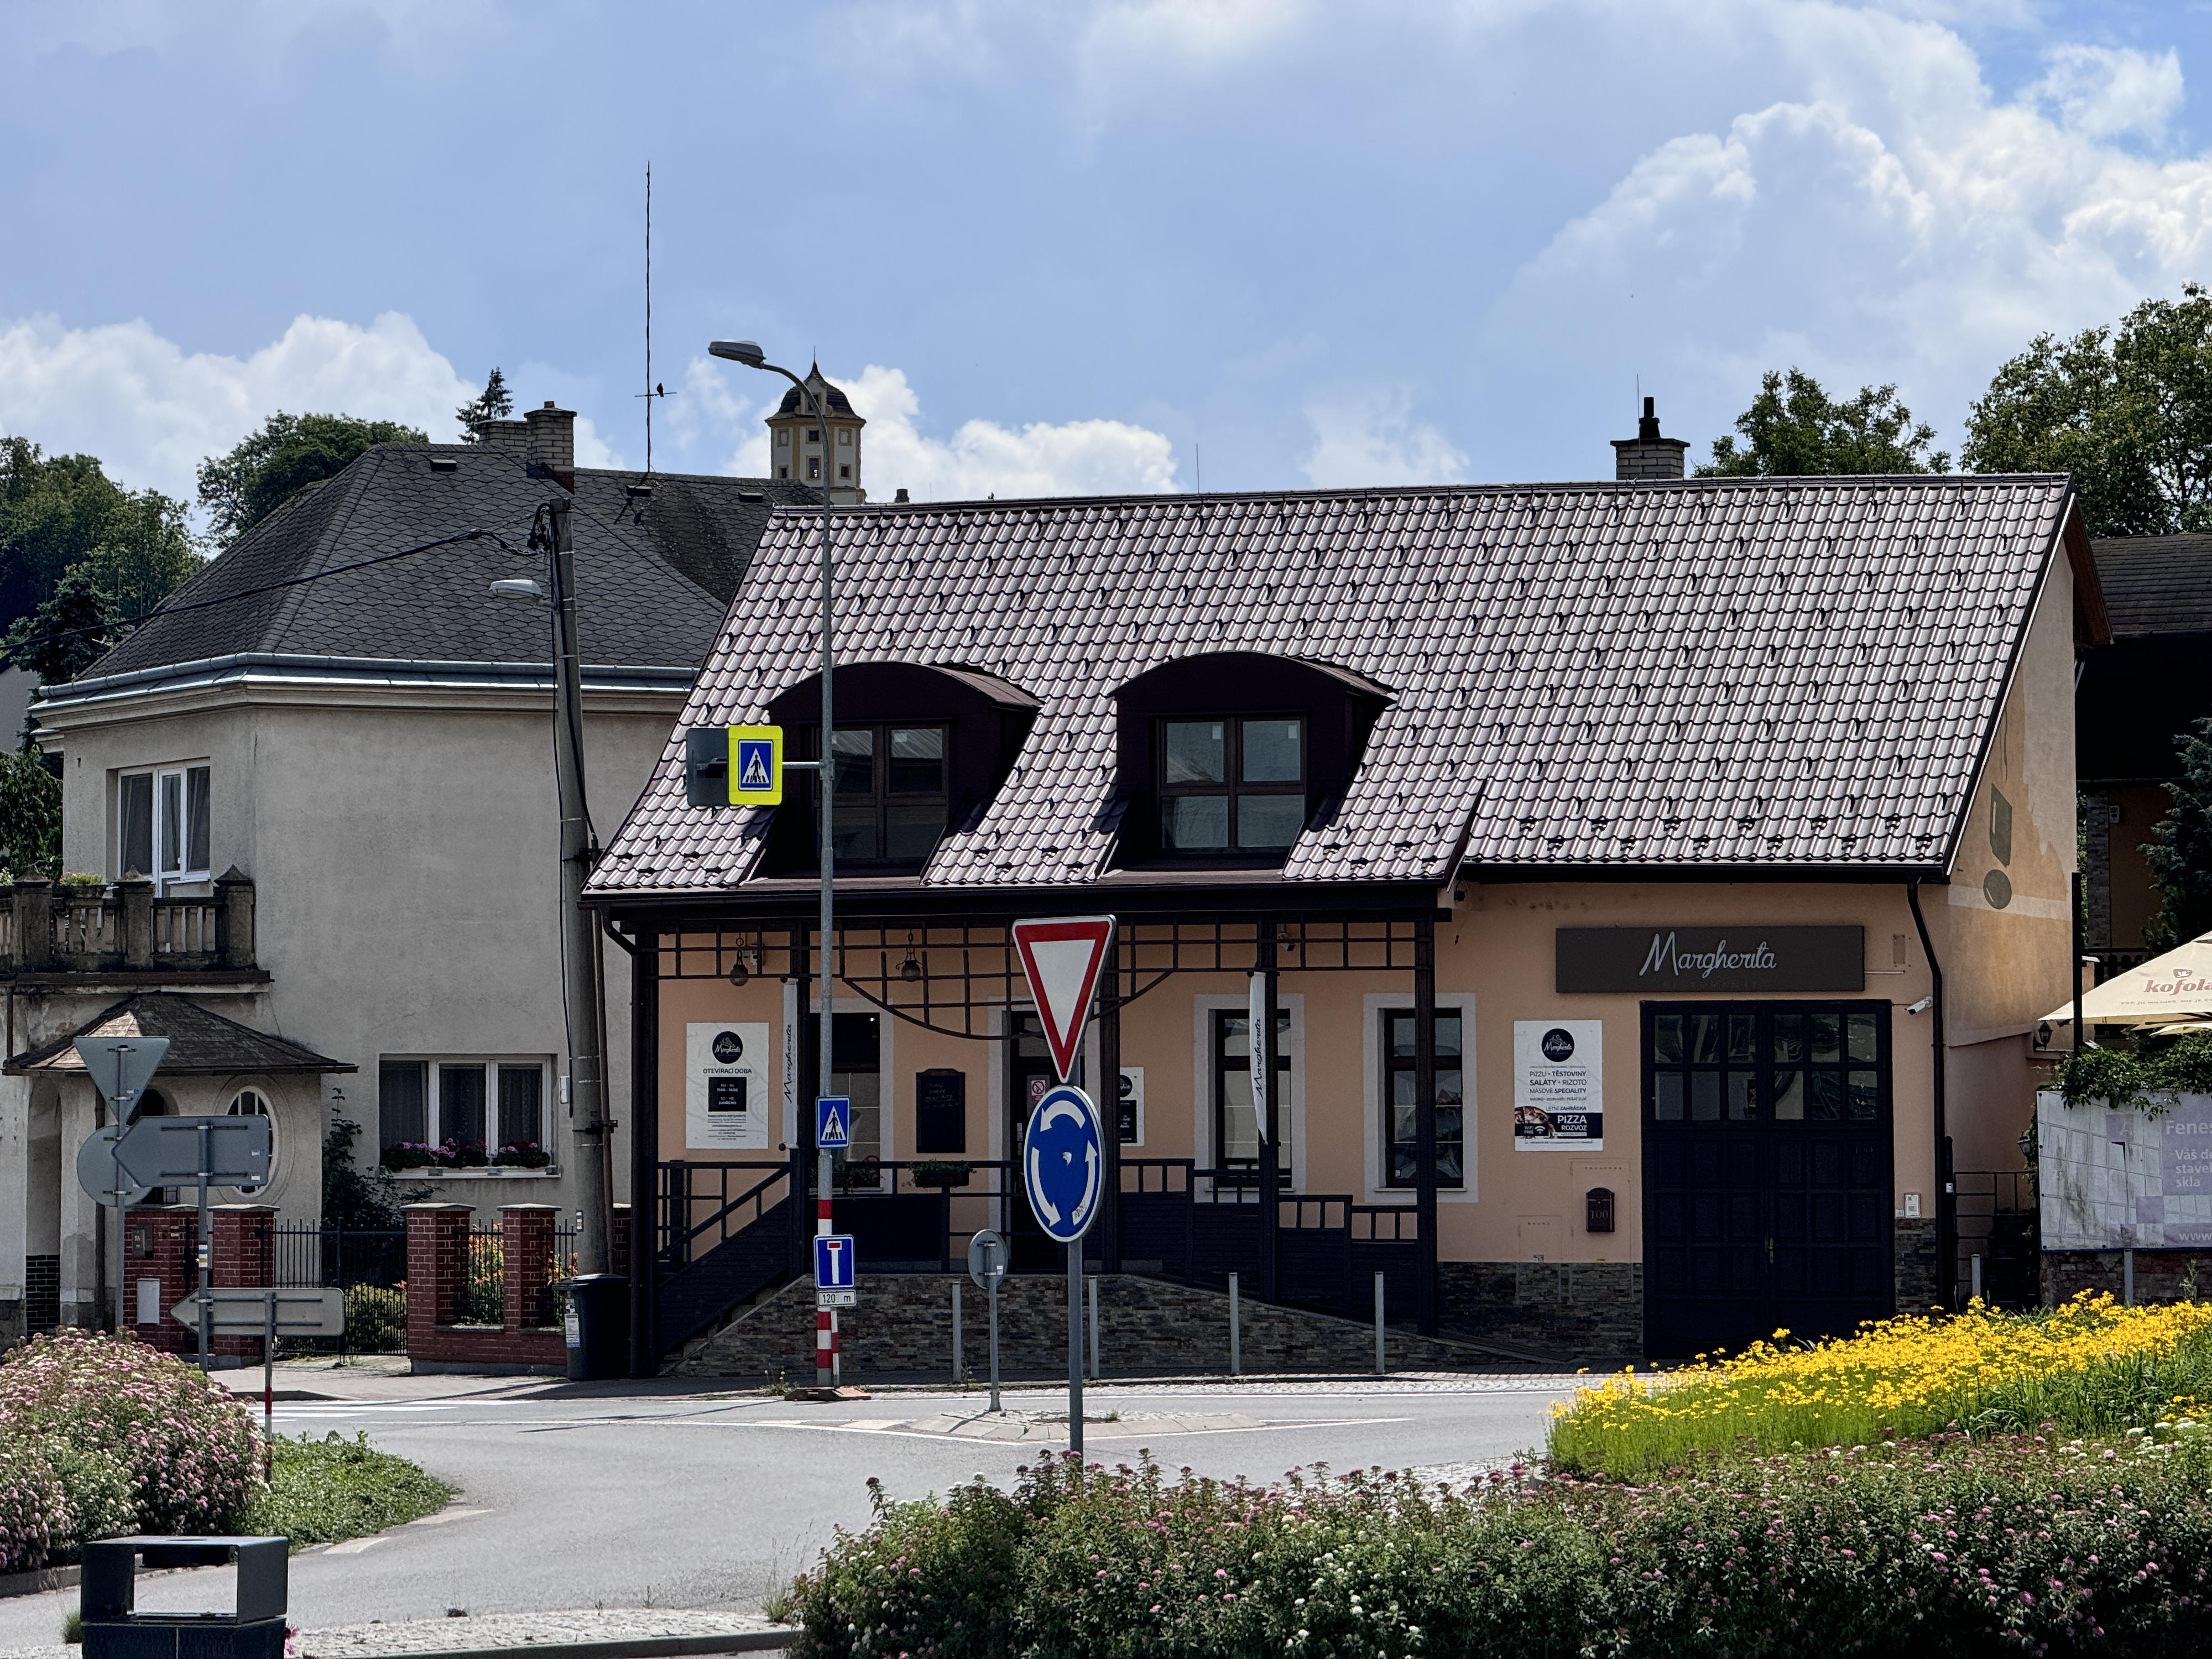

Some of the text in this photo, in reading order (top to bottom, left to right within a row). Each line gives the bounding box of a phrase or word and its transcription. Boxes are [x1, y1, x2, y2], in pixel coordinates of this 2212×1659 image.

[1639, 931, 1777, 978] Margherita
[784, 1024, 792, 1104] Margherita
[1254, 1018, 1263, 1099] Margherita
[1557, 1115, 1587, 1124] PIZZA
[2175, 1149, 2197, 1160] Váš
[2176, 1176, 2201, 1187] skla
[822, 1294, 836, 1303] 120
